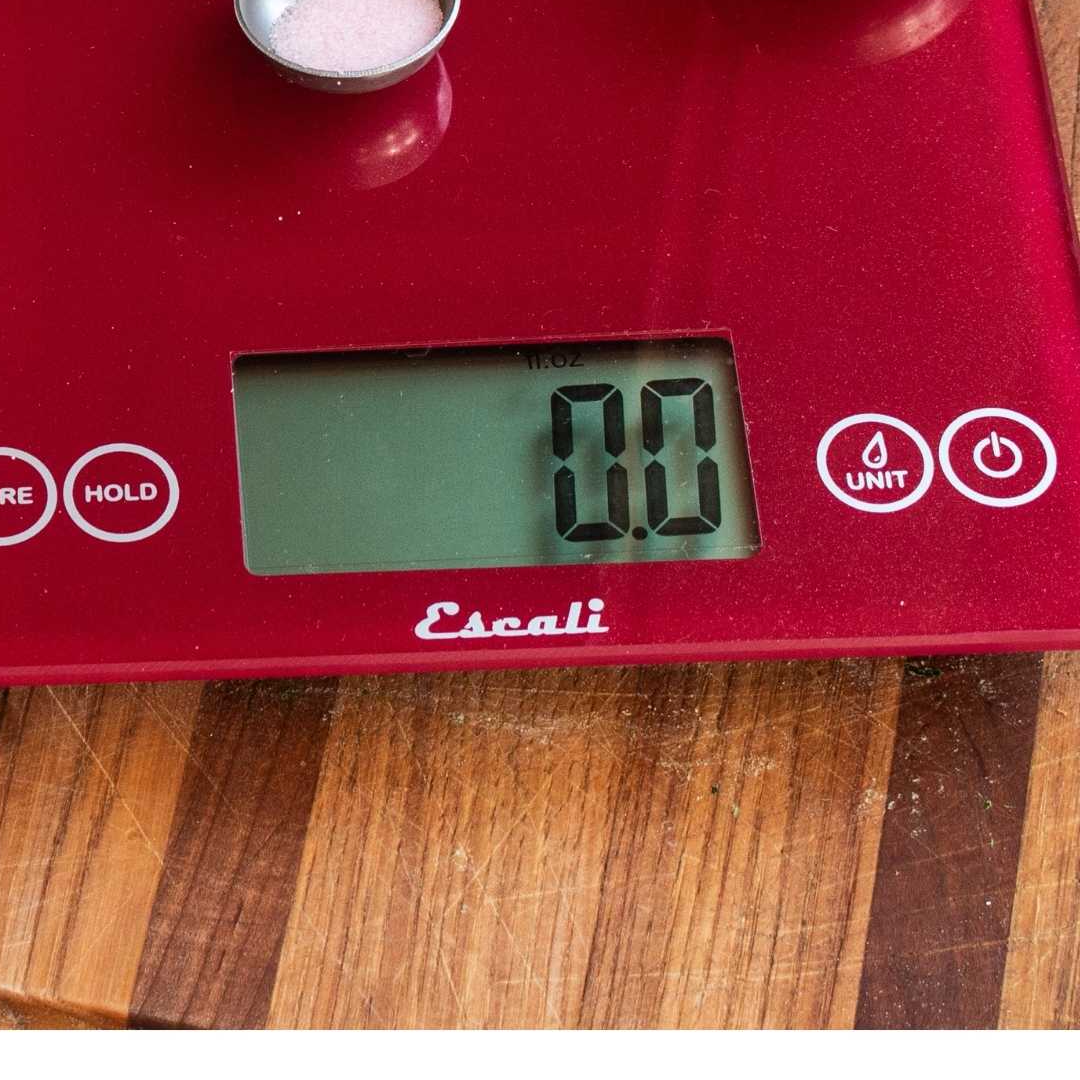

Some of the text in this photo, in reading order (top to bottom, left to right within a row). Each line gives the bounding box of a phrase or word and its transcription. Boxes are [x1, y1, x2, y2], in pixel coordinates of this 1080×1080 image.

[550, 377, 722, 542] 0.0
[84, 482, 158, 503] HOLD
[845, 470, 909, 491] UNIT
[414, 597, 610, 640] Escali
